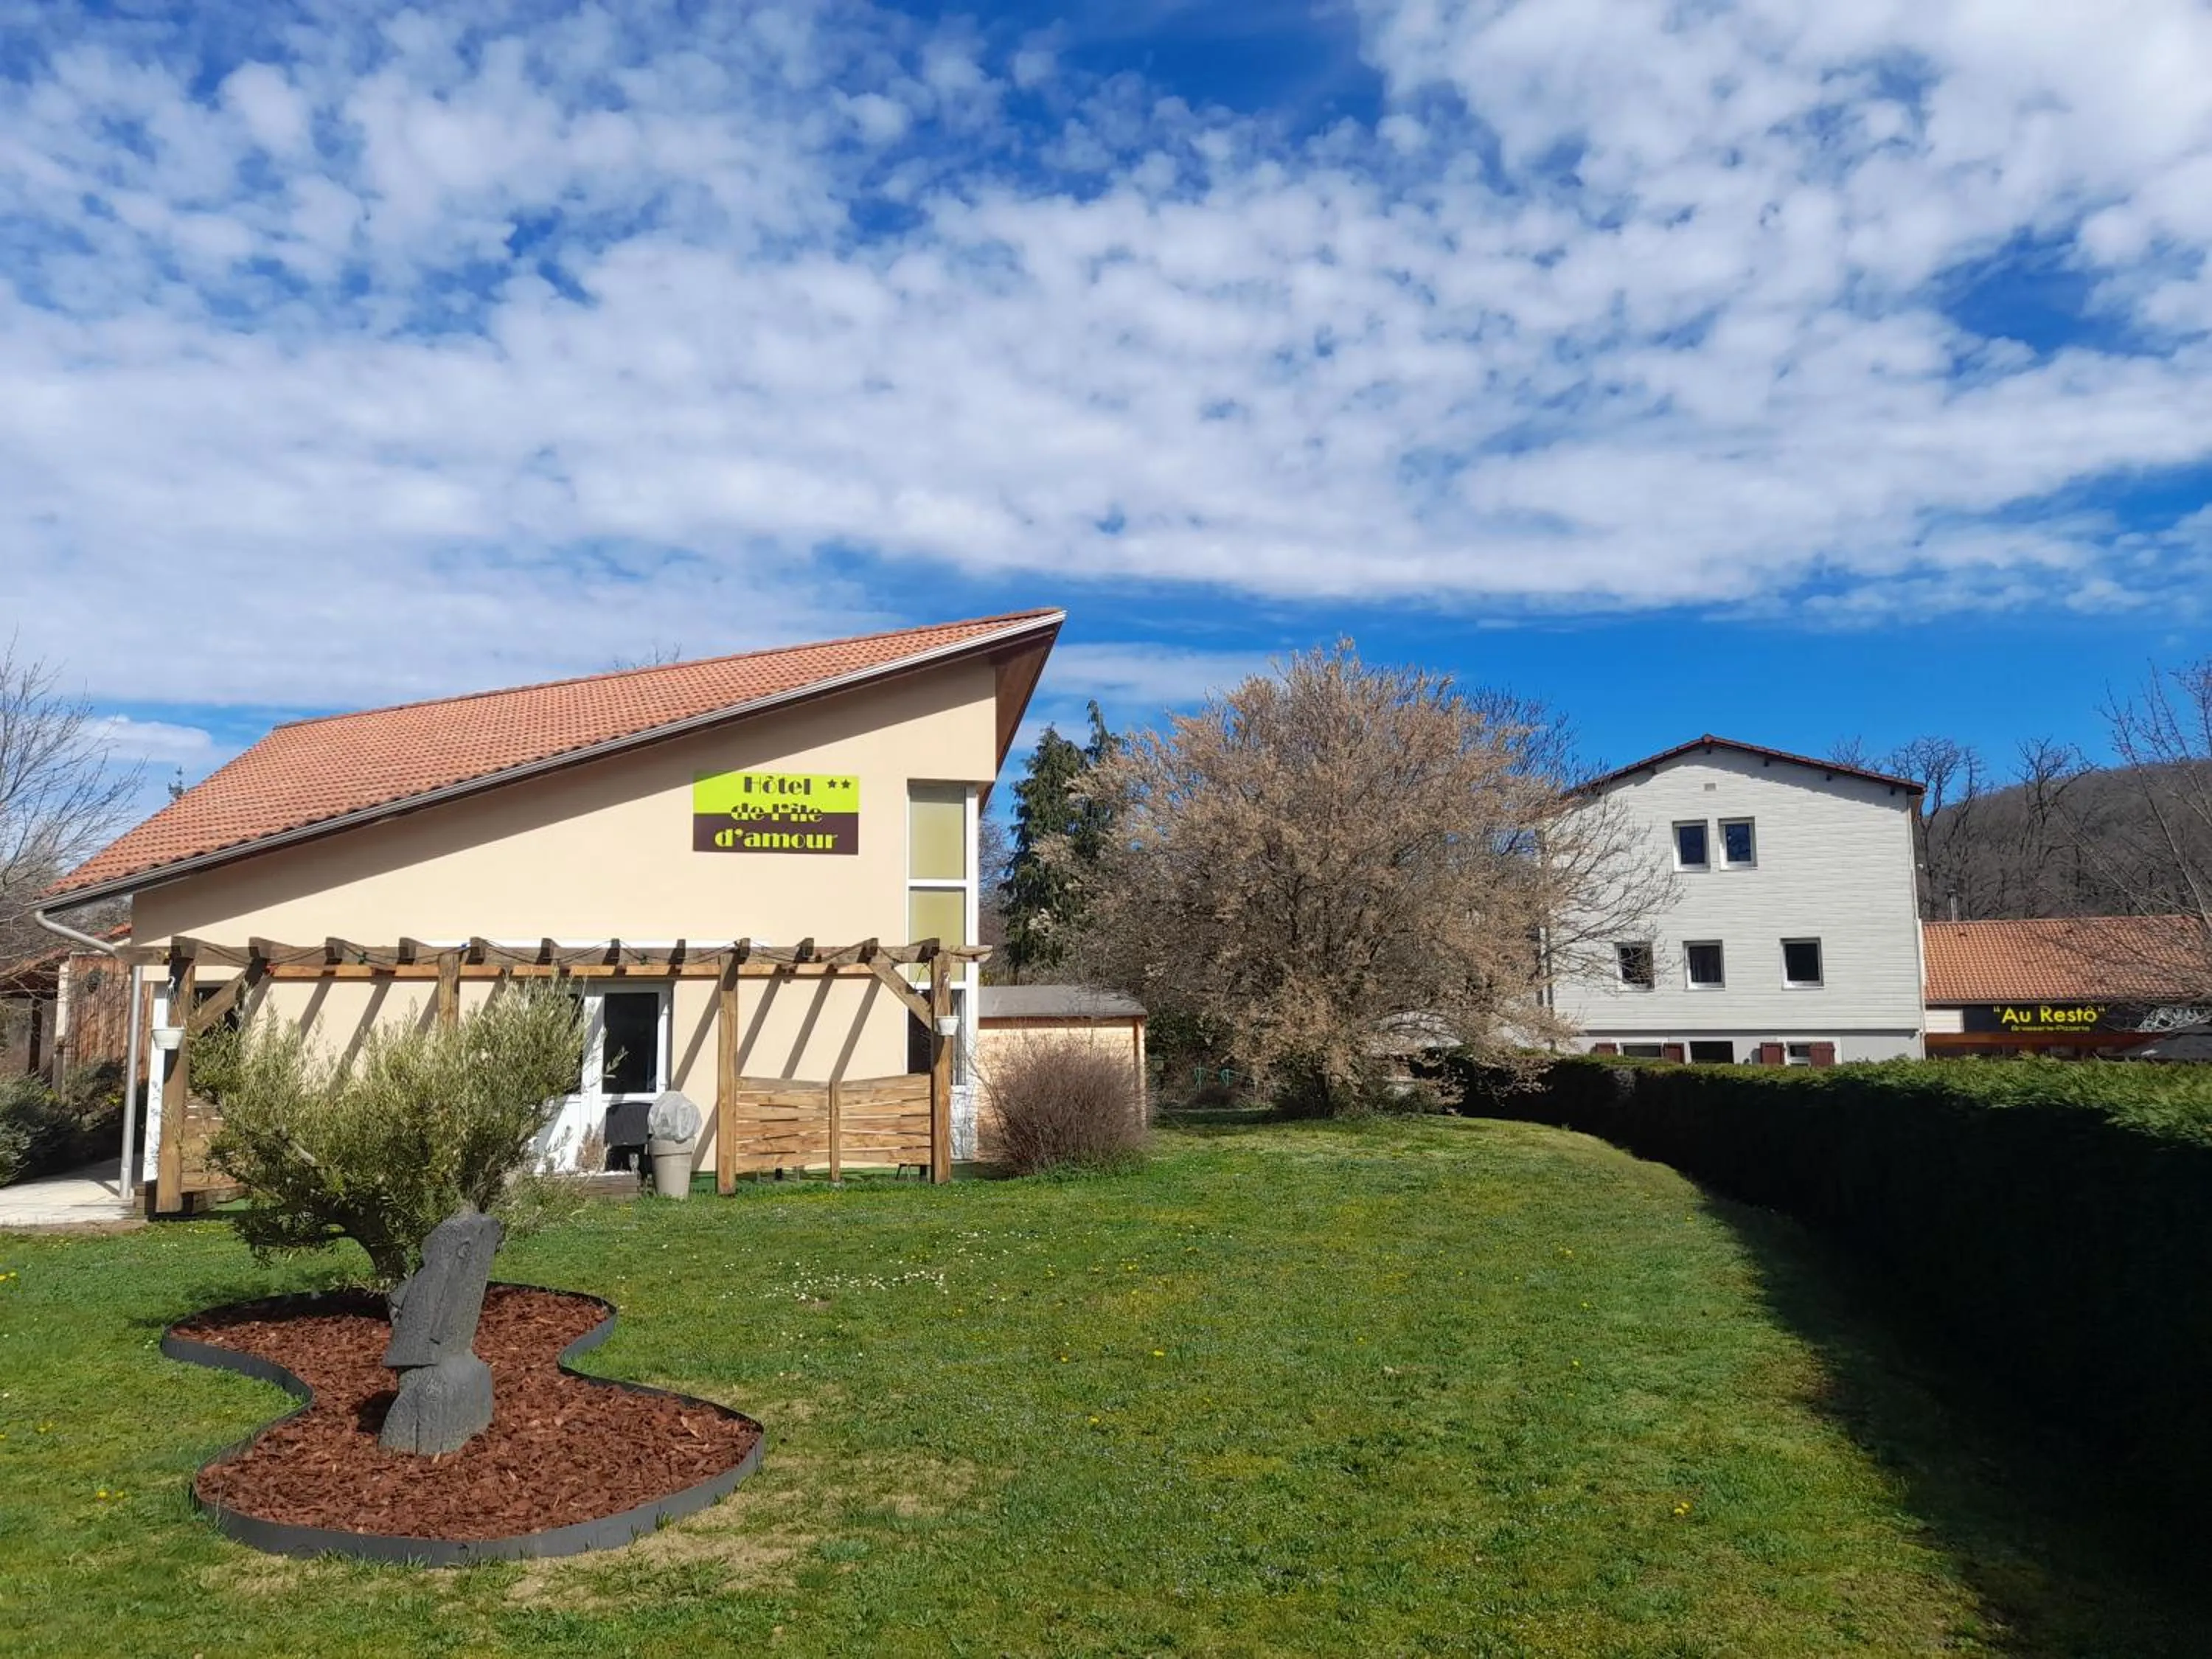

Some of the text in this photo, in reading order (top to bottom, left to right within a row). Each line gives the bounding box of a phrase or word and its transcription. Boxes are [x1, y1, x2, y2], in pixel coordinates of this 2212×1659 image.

[744, 776, 810, 795] Hôtel
[731, 802, 765, 820] de
[714, 828, 838, 849] d'amour
